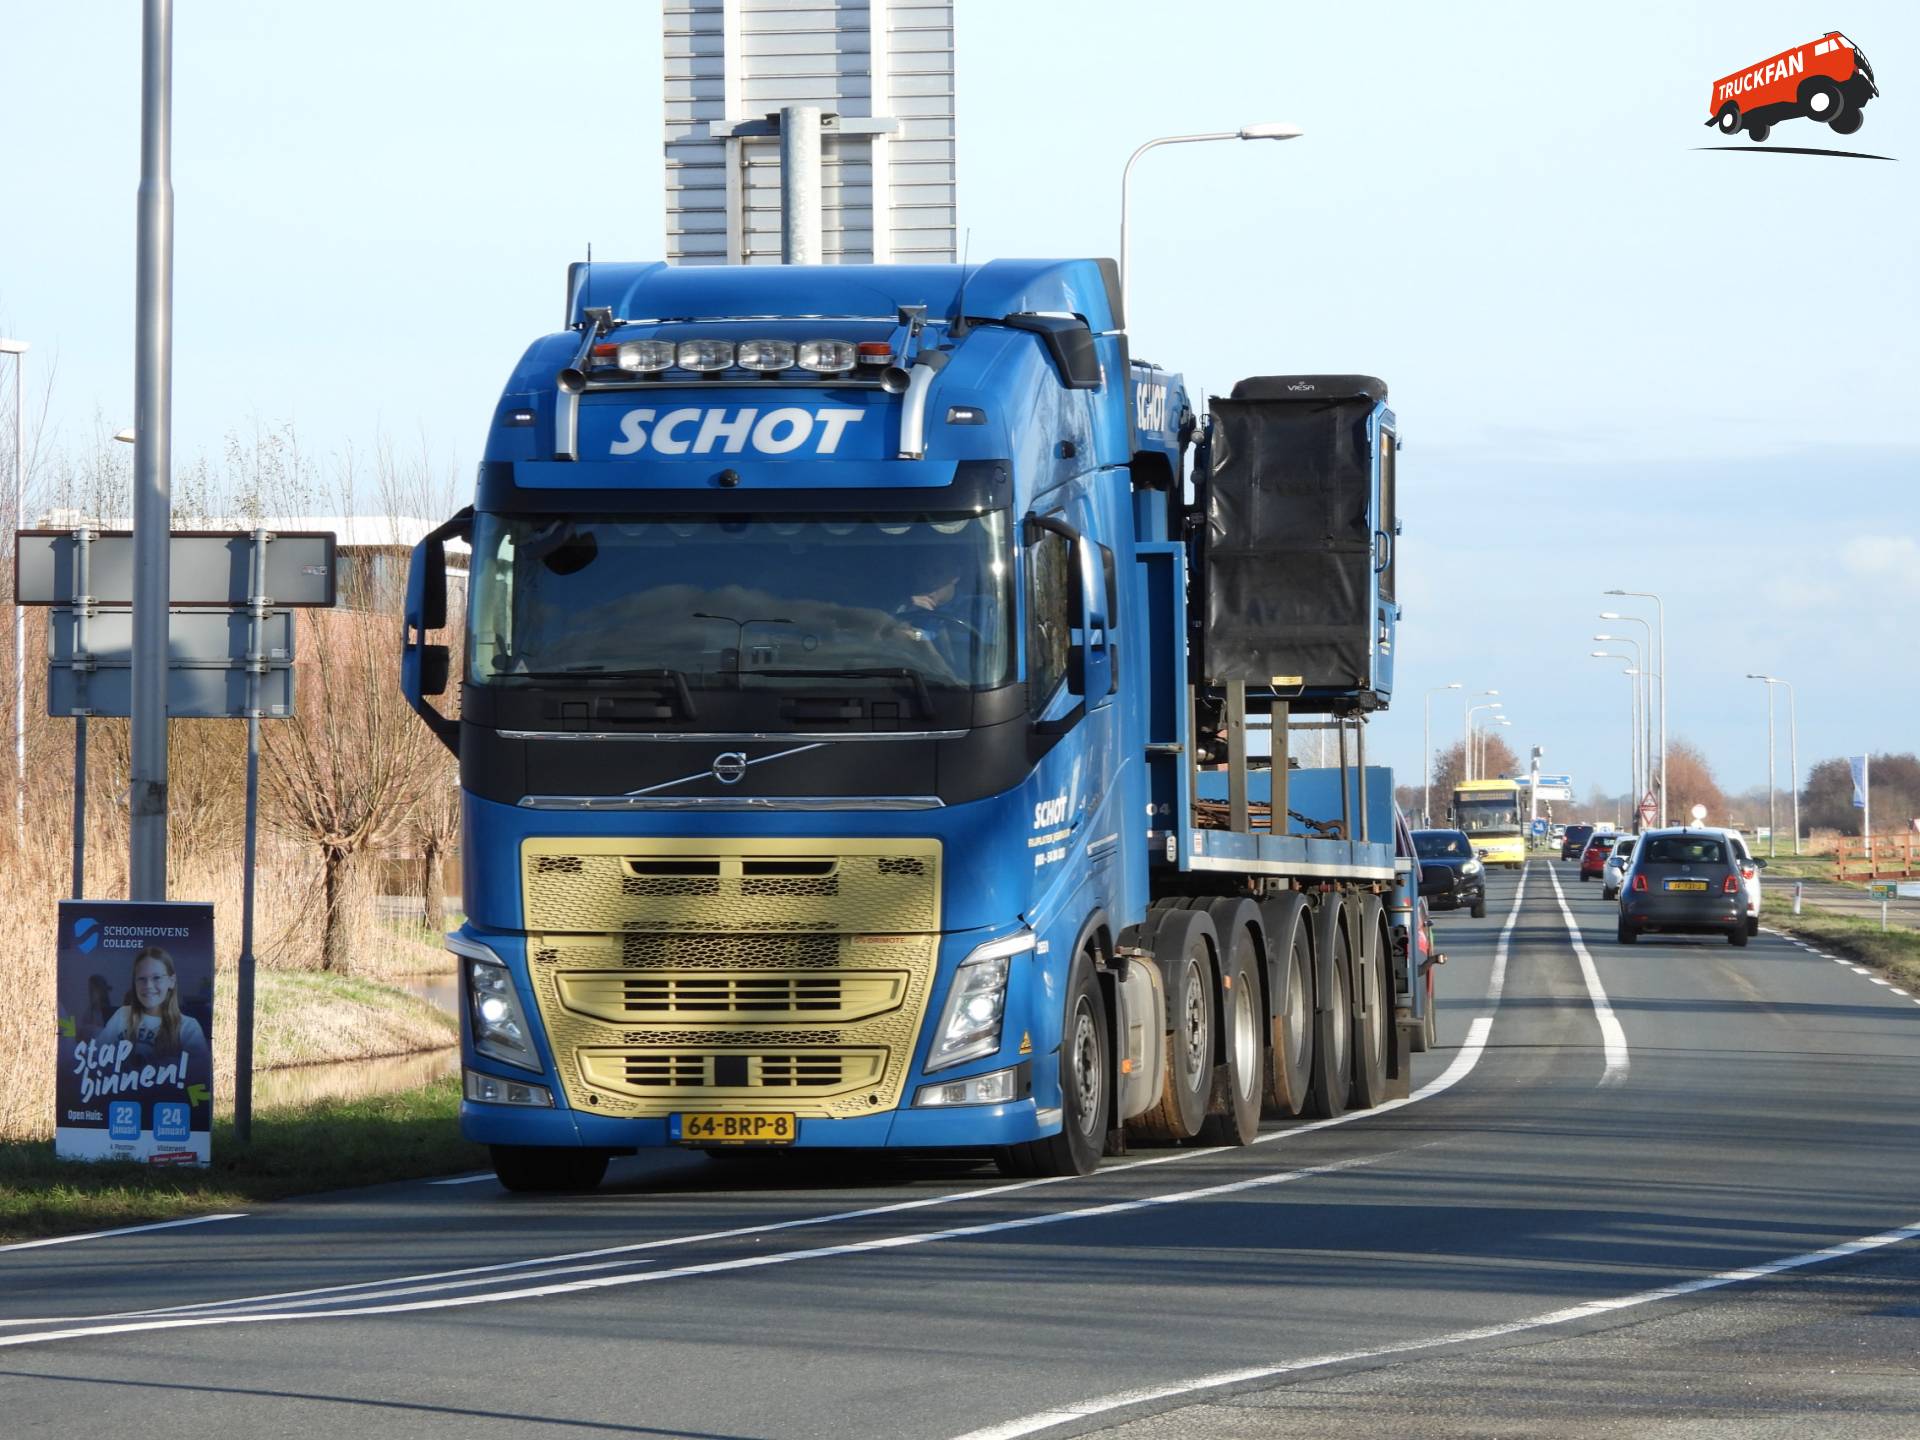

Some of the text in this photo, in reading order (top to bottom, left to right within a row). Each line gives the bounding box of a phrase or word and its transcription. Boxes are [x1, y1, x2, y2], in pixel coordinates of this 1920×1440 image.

[1136, 382, 1167, 431] SCHOT
[609, 407, 866, 455] SCHOT
[1034, 796, 1067, 829] SCHOT
[103, 926, 190, 937] SCHOONHOVENS
[103, 938, 144, 948] COLLEGE
[73, 1038, 133, 1075] stap
[81, 1050, 189, 1103] binnen!
[67, 1109, 104, 1120] Open Huis:
[116, 1106, 134, 1124] 22
[162, 1108, 182, 1125] 24
[112, 1125, 137, 1135] januari
[157, 1126, 186, 1136] januari
[688, 1117, 788, 1136] 64-BRP-8
